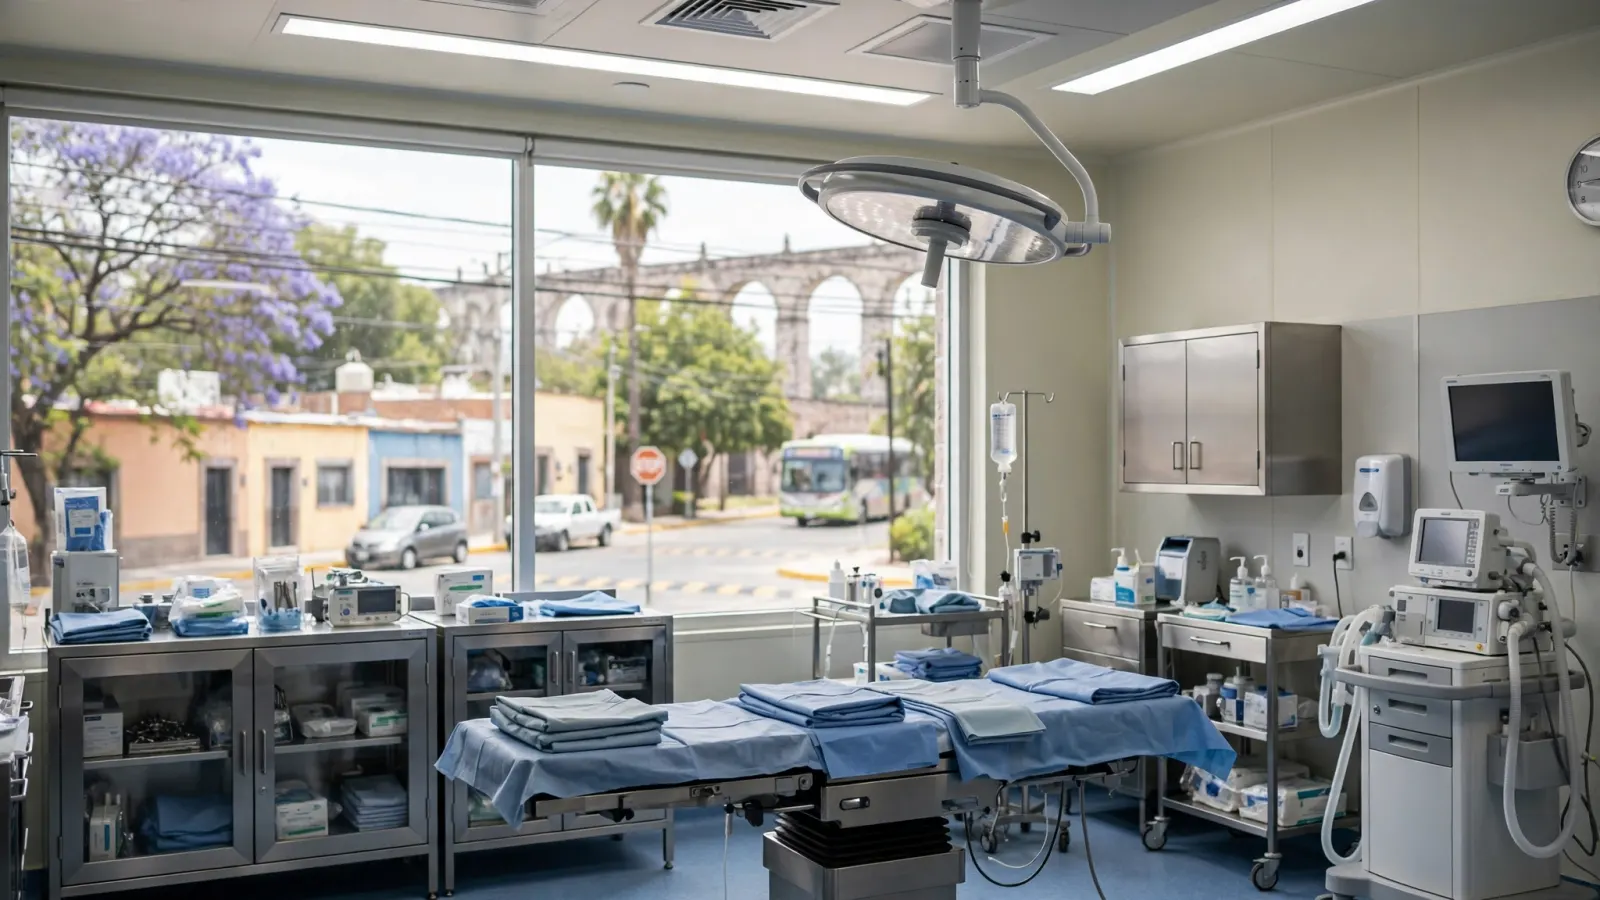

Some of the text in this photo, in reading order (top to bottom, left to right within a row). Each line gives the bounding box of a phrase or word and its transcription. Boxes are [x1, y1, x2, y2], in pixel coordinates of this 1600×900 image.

[1580, 164, 1588, 175] 10
[1577, 180, 1581, 189] 9
[1581, 195, 1586, 204] 8
